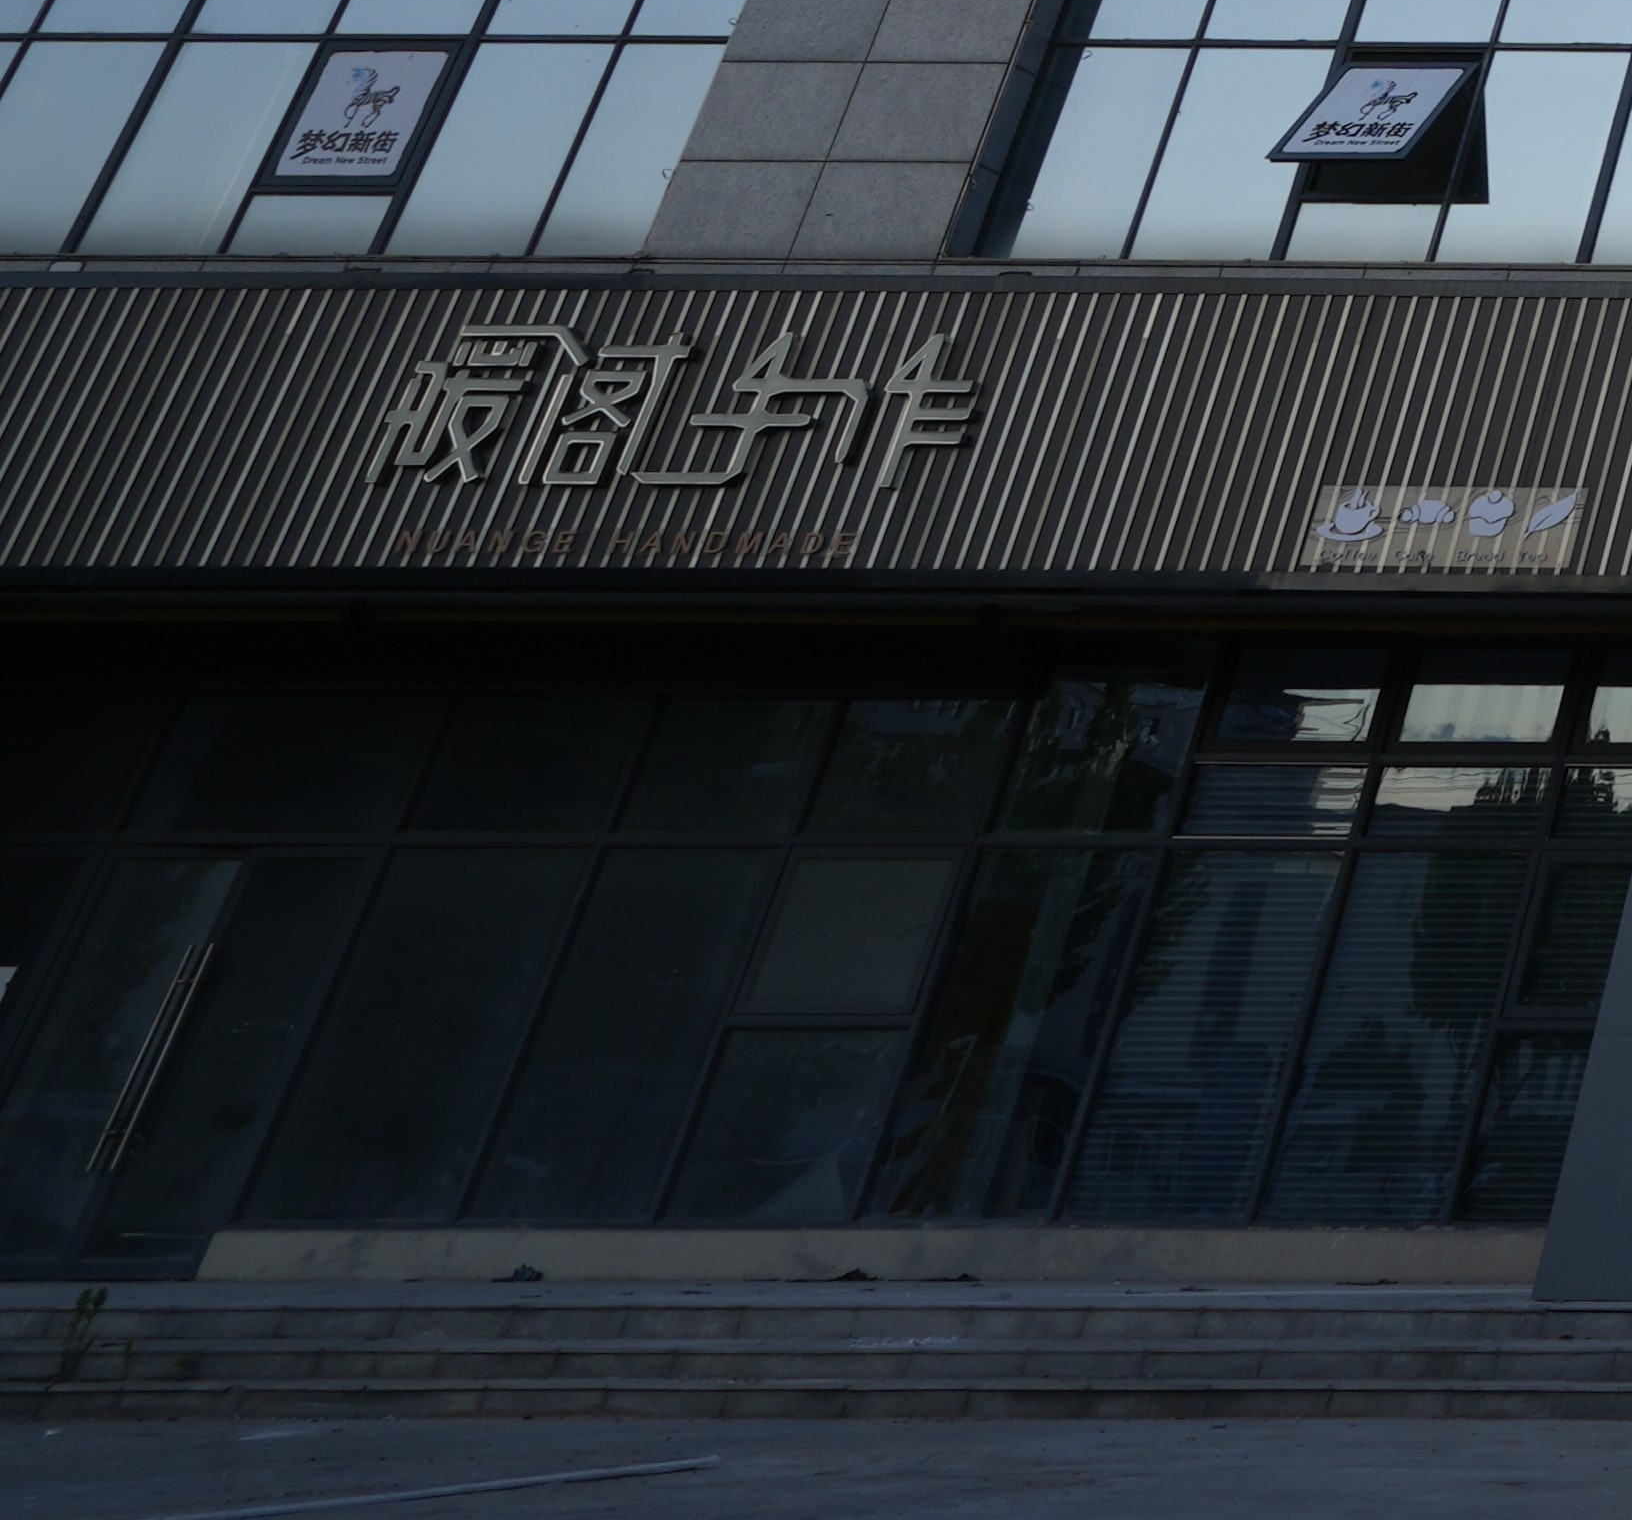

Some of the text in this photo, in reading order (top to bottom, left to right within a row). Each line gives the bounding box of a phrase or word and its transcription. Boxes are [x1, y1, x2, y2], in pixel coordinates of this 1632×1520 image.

[289, 129, 400, 160] 梦幻新街
[1302, 121, 1415, 143] 梦幻新街
[357, 156, 388, 165] Street
[365, 323, 982, 491] 暖阁手作
[396, 528, 861, 558] NUANGE HANDMADE
